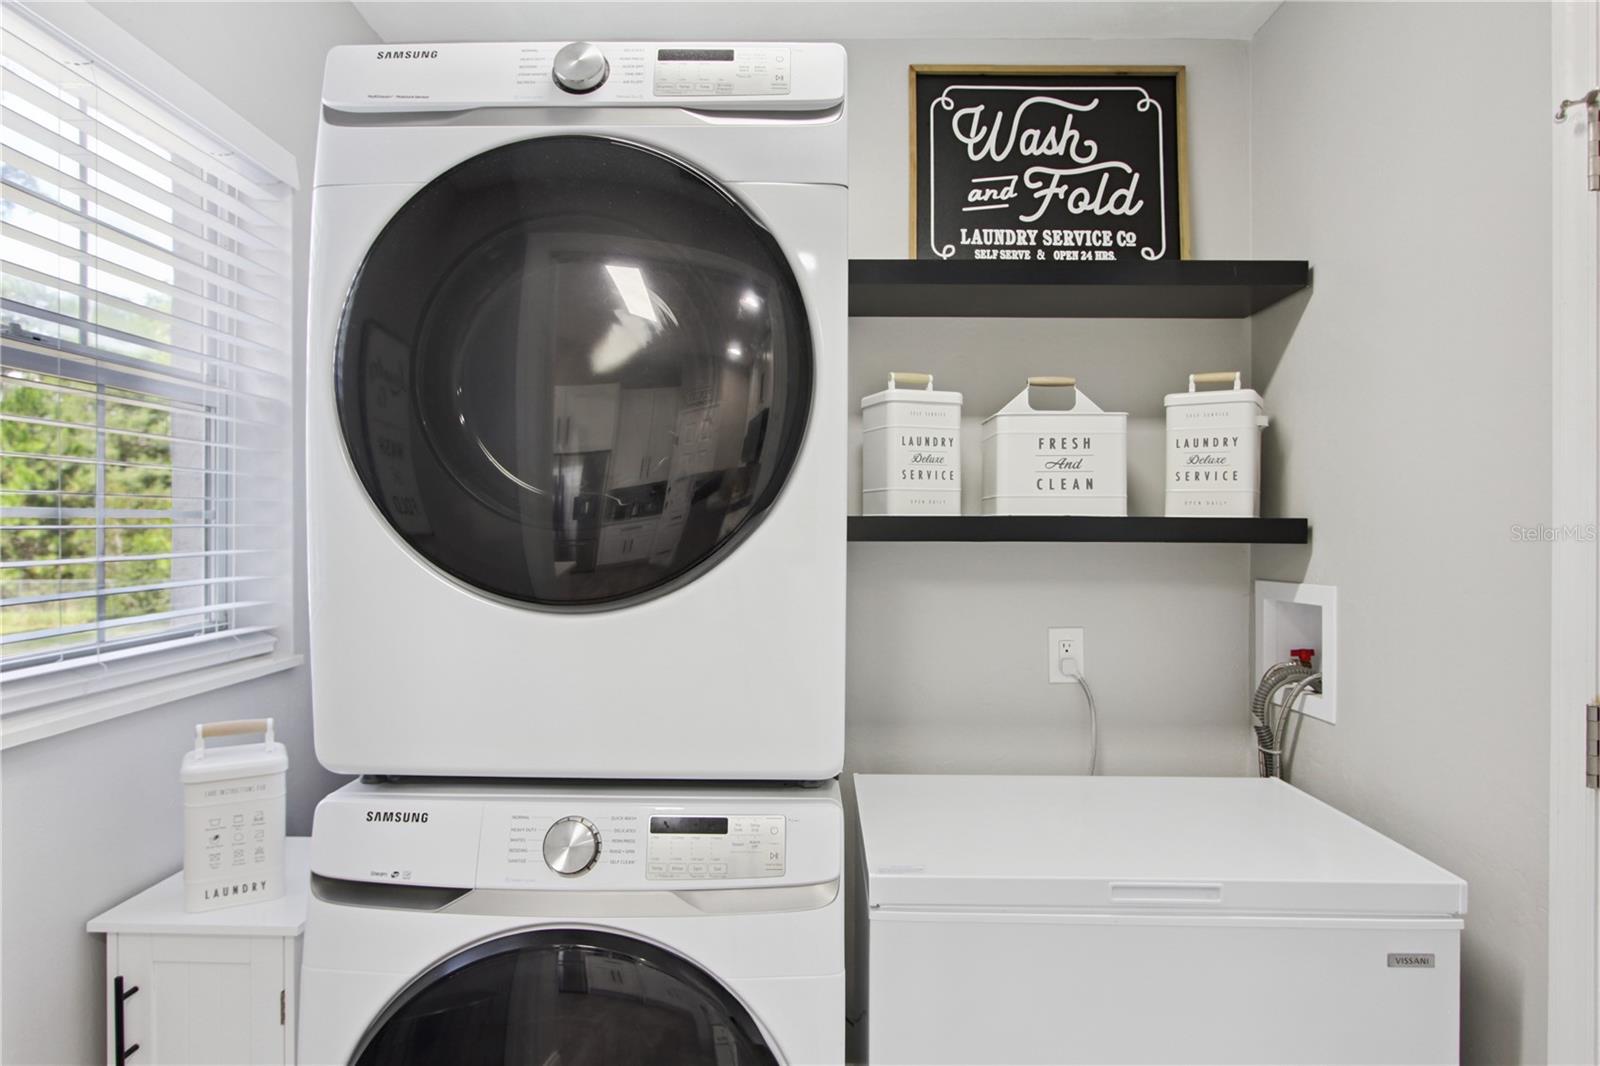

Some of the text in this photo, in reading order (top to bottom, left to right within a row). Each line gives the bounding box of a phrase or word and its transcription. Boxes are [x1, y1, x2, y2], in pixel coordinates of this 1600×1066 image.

[377, 50, 438, 60] SAMSUNG
[952, 96, 1099, 163] Wash
[967, 176, 1018, 202] and
[1019, 161, 1144, 222] Fold
[960, 228, 1037, 246] LAUNDRY
[1042, 229, 1113, 247] SERVICE
[974, 249, 1117, 260] SELF SERVE & OPEN 24 HRS.
[901, 436, 954, 448] LAUNDRY
[1038, 437, 1091, 450] FRESH
[1175, 437, 1239, 448] LAUNDRY
[912, 453, 944, 464] Deluxe
[1045, 458, 1082, 470] And
[1187, 454, 1226, 464] Deluxe
[902, 469, 954, 480] SERVICE
[1175, 471, 1239, 481] SERVICE
[1036, 478, 1094, 490] CLEAN
[366, 811, 429, 823] SAMSUNG
[204, 881, 267, 900] LAUNDRY
[1395, 956, 1430, 965] VISSANI
